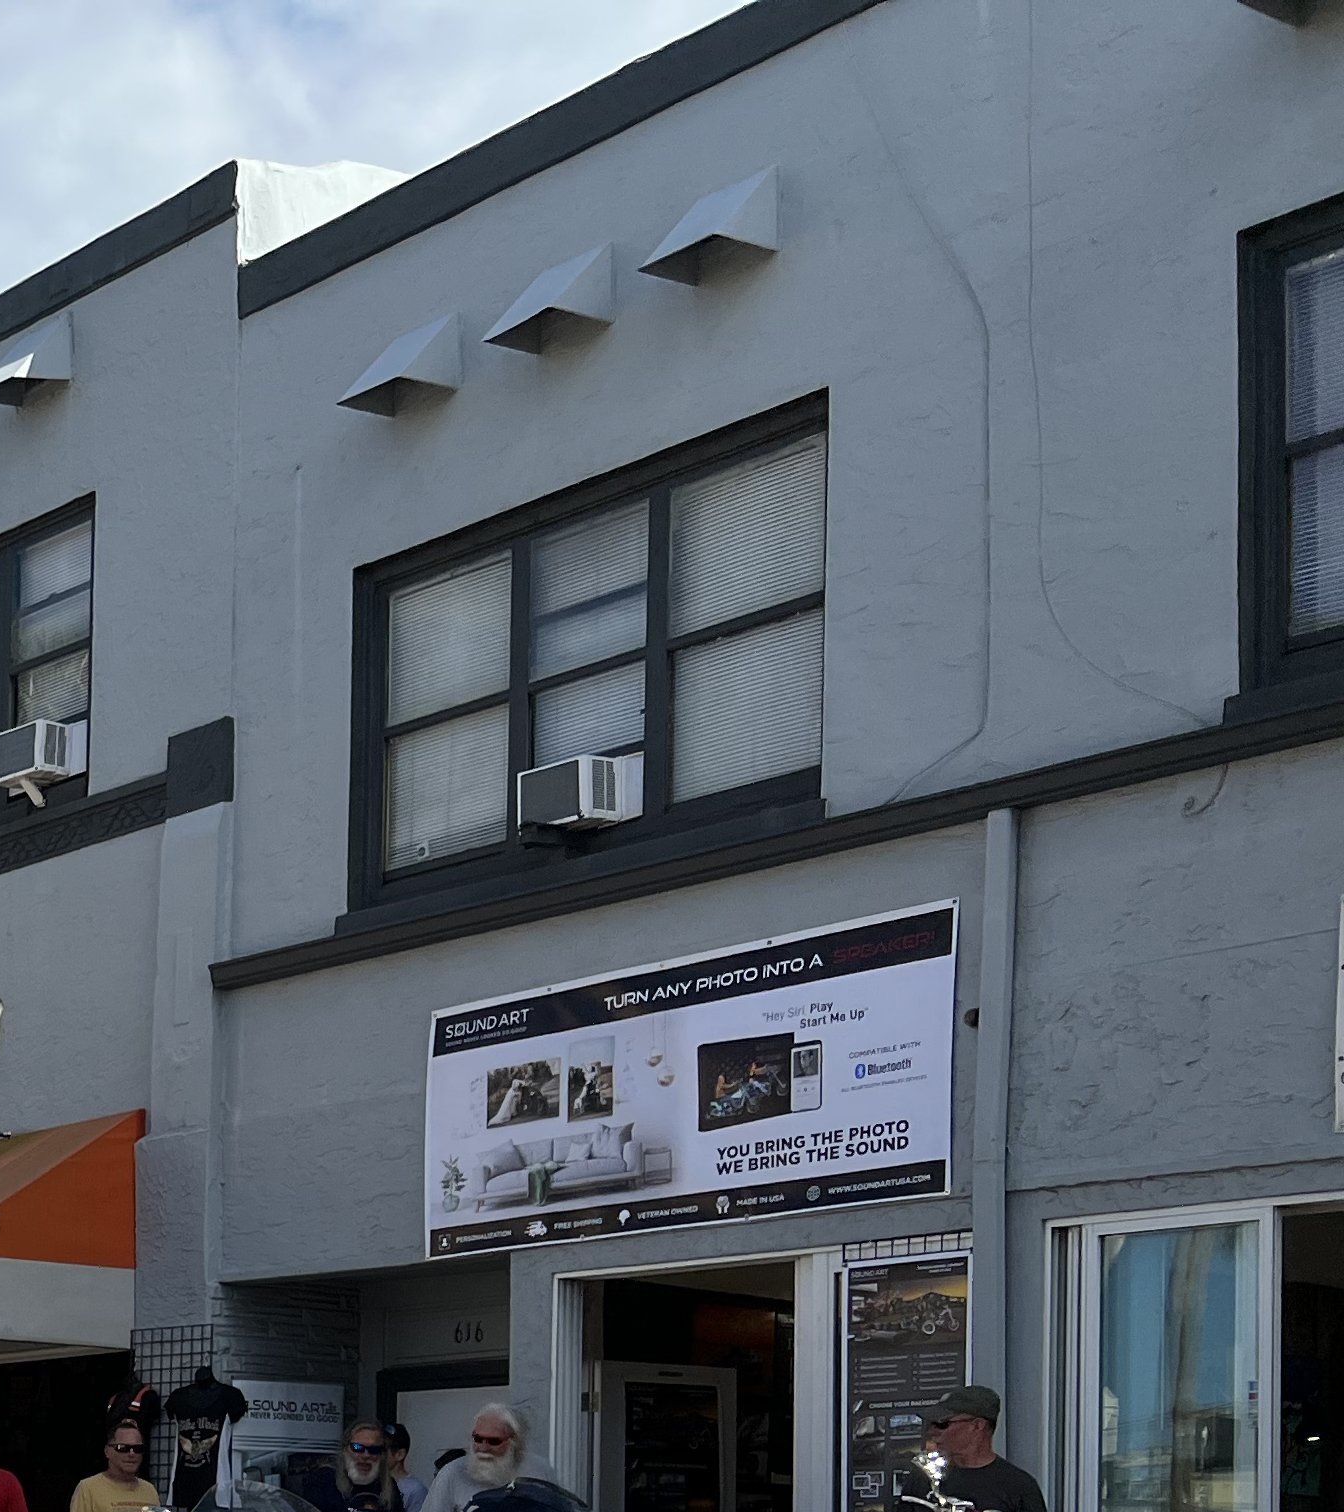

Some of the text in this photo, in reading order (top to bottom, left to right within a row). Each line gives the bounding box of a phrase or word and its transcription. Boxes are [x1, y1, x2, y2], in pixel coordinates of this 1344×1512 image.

[604, 930, 936, 1011] TURN ANY PHOTO INTO A SPEAKER!
[810, 1002, 833, 1014] Play
[800, 1016, 827, 1029] Start
[830, 1012, 846, 1024] Me
[848, 1040, 921, 1059] COMPATIBLE WITH
[867, 1057, 912, 1076] Bluetooth
[717, 1119, 909, 1160] YOU BRING THE PHOTO
[717, 1135, 909, 1175] WE BRING THE SOUND
[736, 1193, 785, 1207] MADE IN USA
[454, 1320, 484, 1344] 616
[250, 1411, 271, 1419] NEVER
[252, 1400, 326, 1413] SOUND ART
